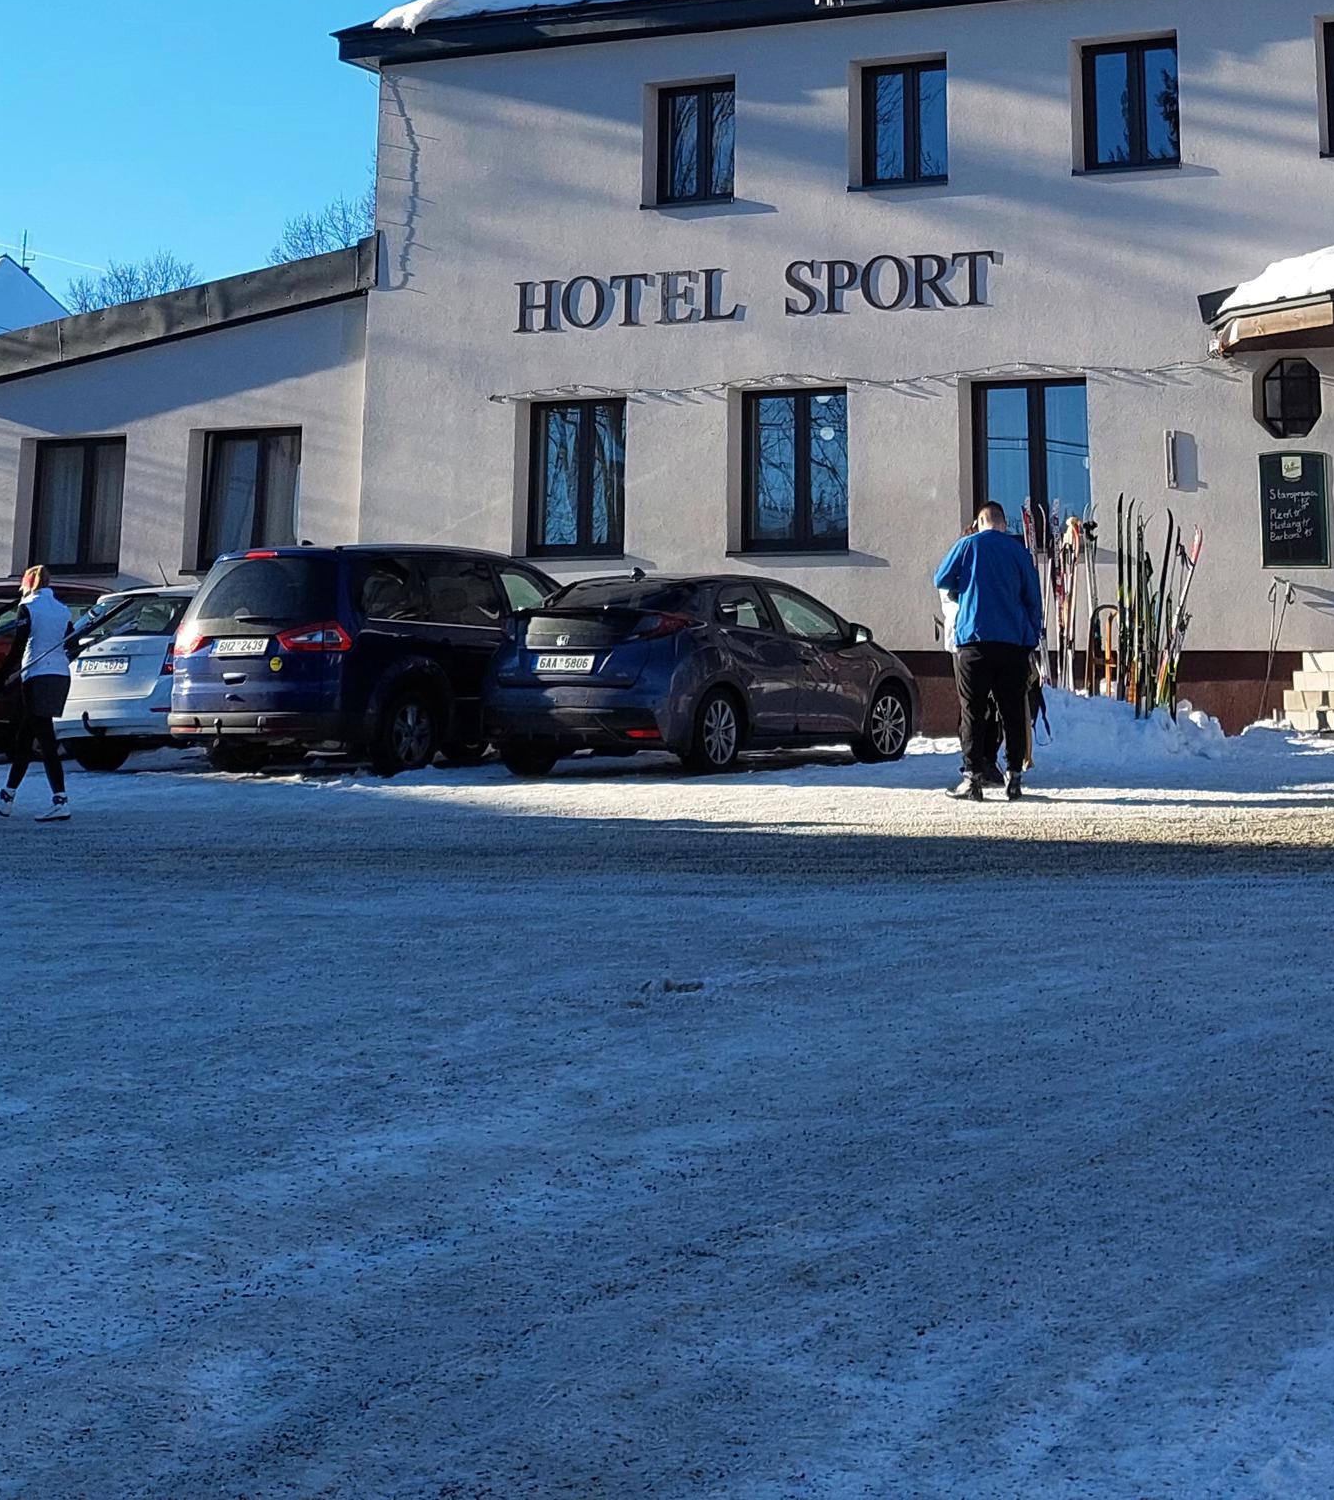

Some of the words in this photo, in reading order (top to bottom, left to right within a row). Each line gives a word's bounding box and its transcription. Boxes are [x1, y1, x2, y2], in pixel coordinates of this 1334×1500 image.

[513, 268, 746, 333] HOTEL
[784, 250, 1003, 316] SPORT
[240, 640, 263, 651] 2439
[539, 658, 557, 668] 6AA
[564, 658, 589, 668] 5806
